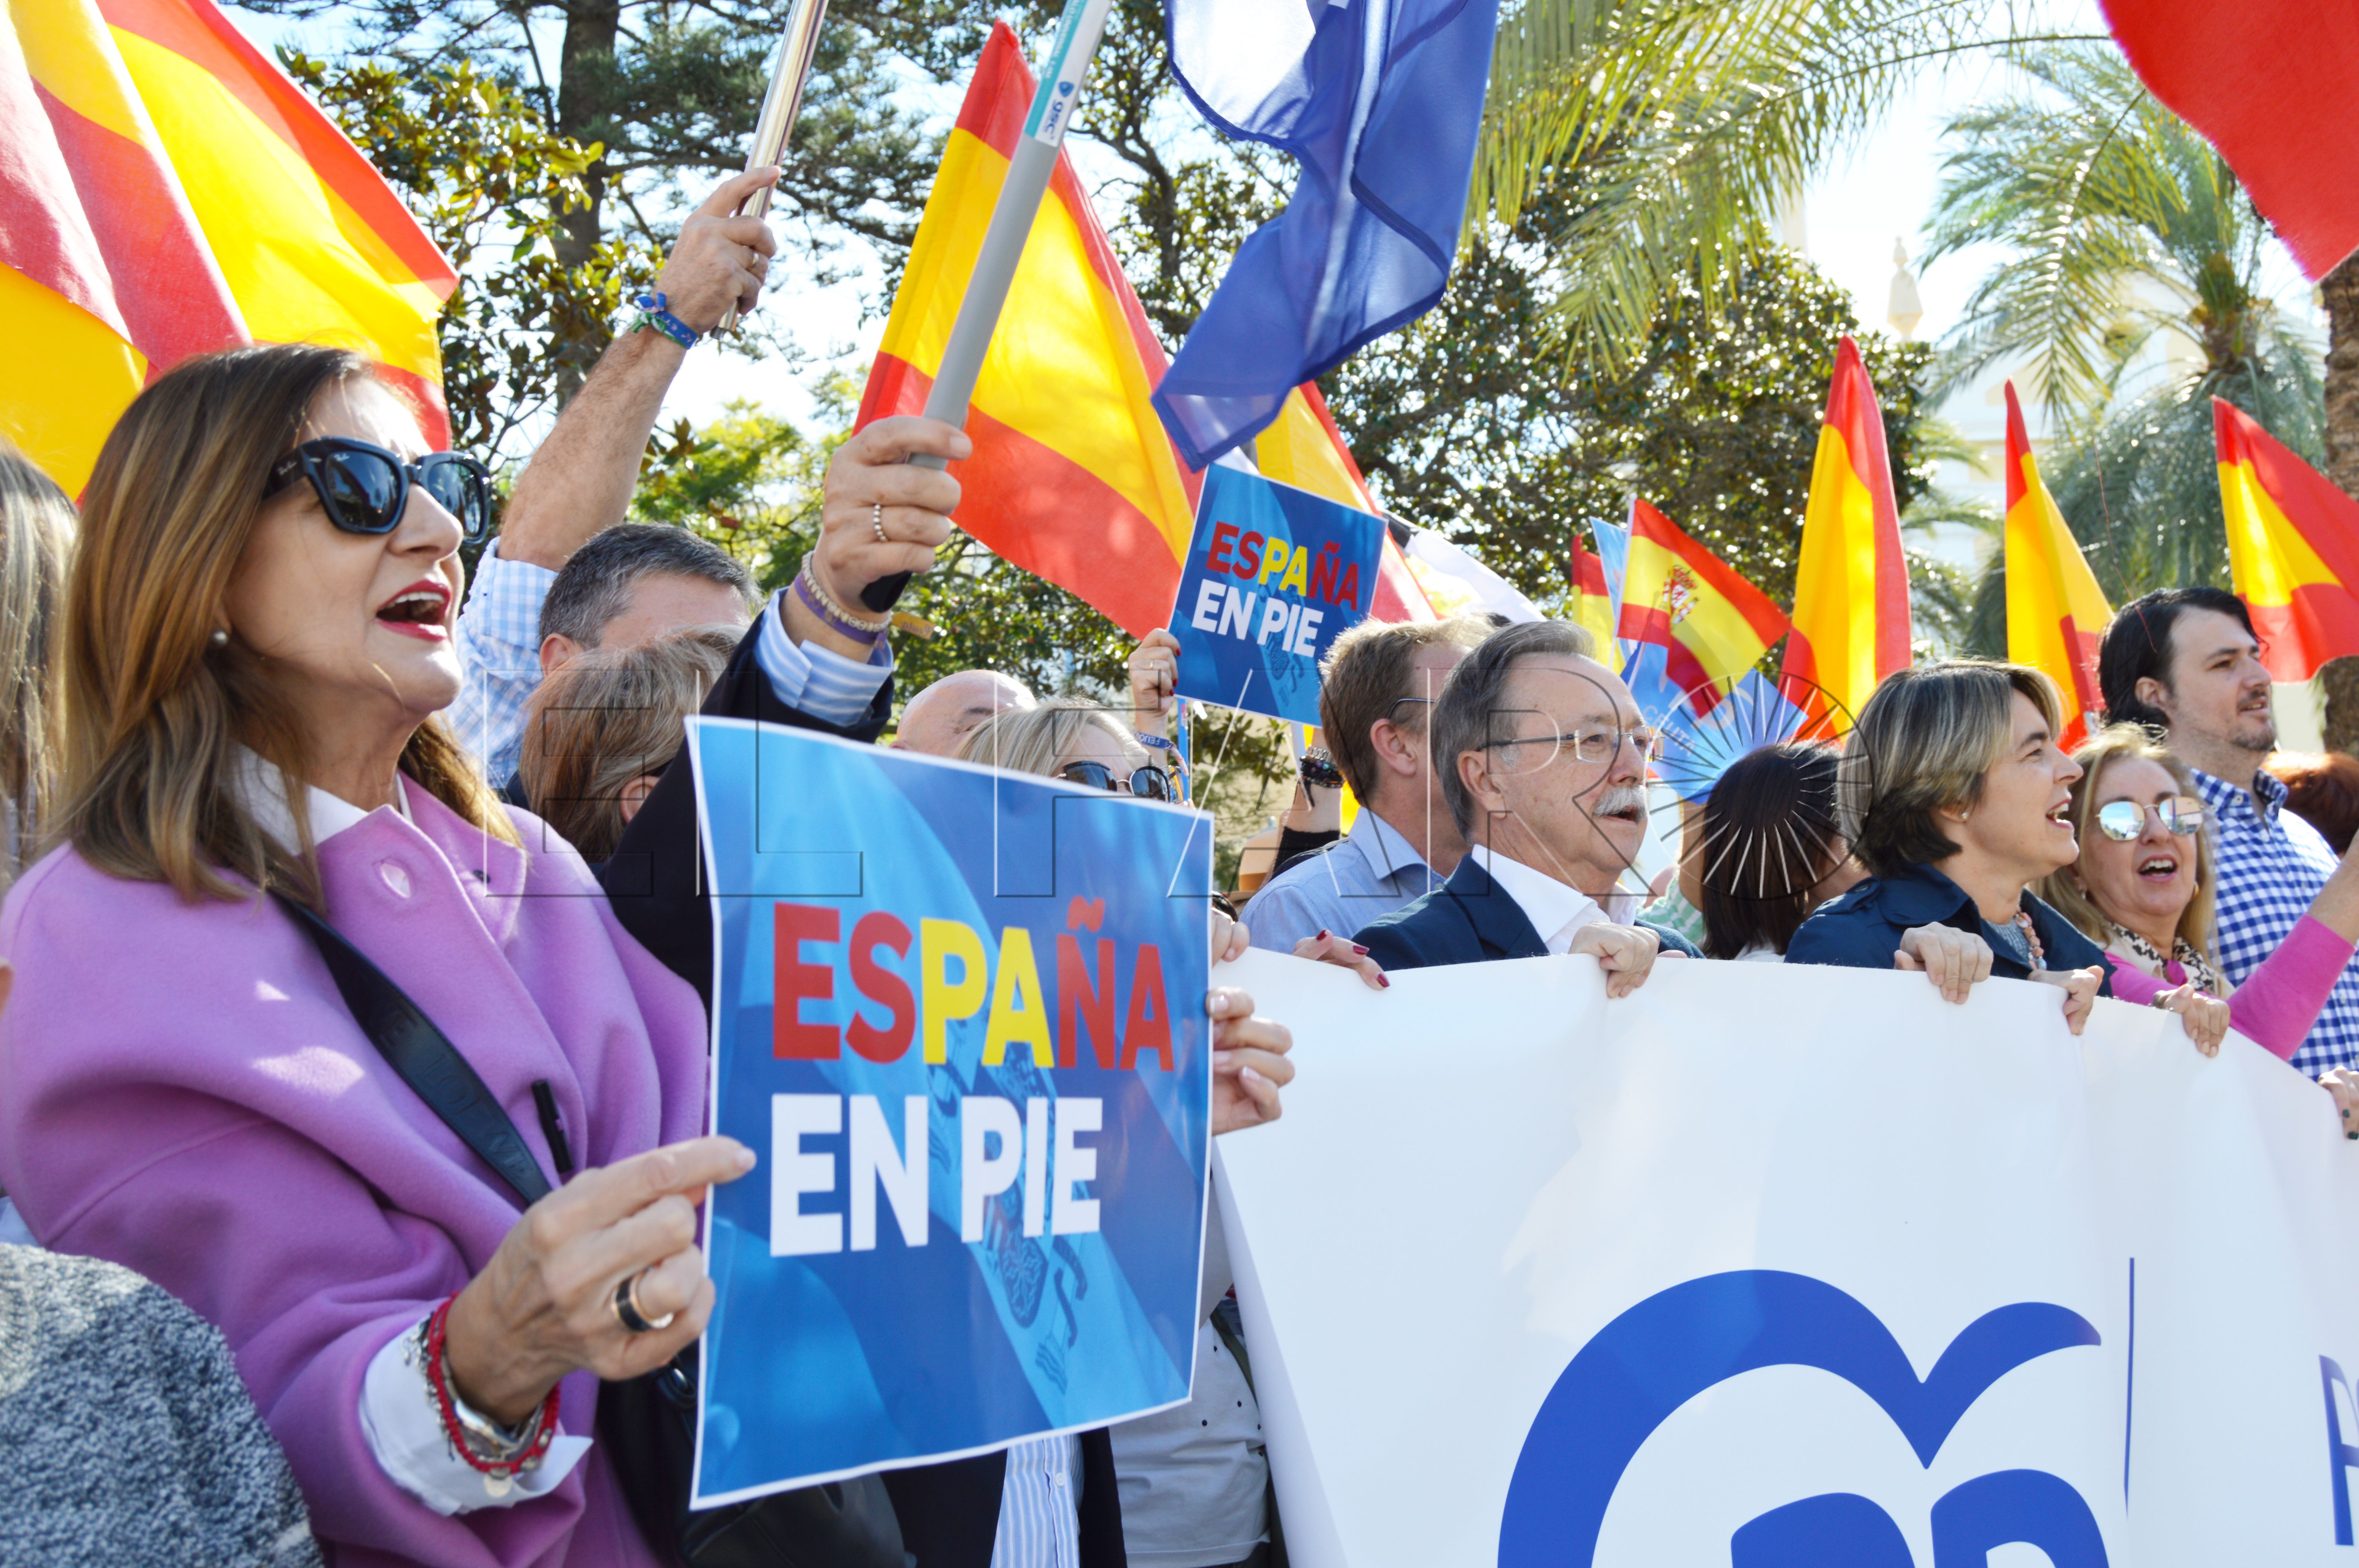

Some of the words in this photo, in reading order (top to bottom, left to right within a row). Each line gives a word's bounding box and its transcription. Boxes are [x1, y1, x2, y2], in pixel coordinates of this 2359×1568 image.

[1191, 579, 1257, 641] EN
[1256, 597, 1324, 658] PIE
[1206, 521, 1359, 611] ESPAÑA
[772, 895, 1174, 1071] ESPAÑA
[770, 1093, 929, 1258] EN
[960, 1096, 1103, 1244] PIE
